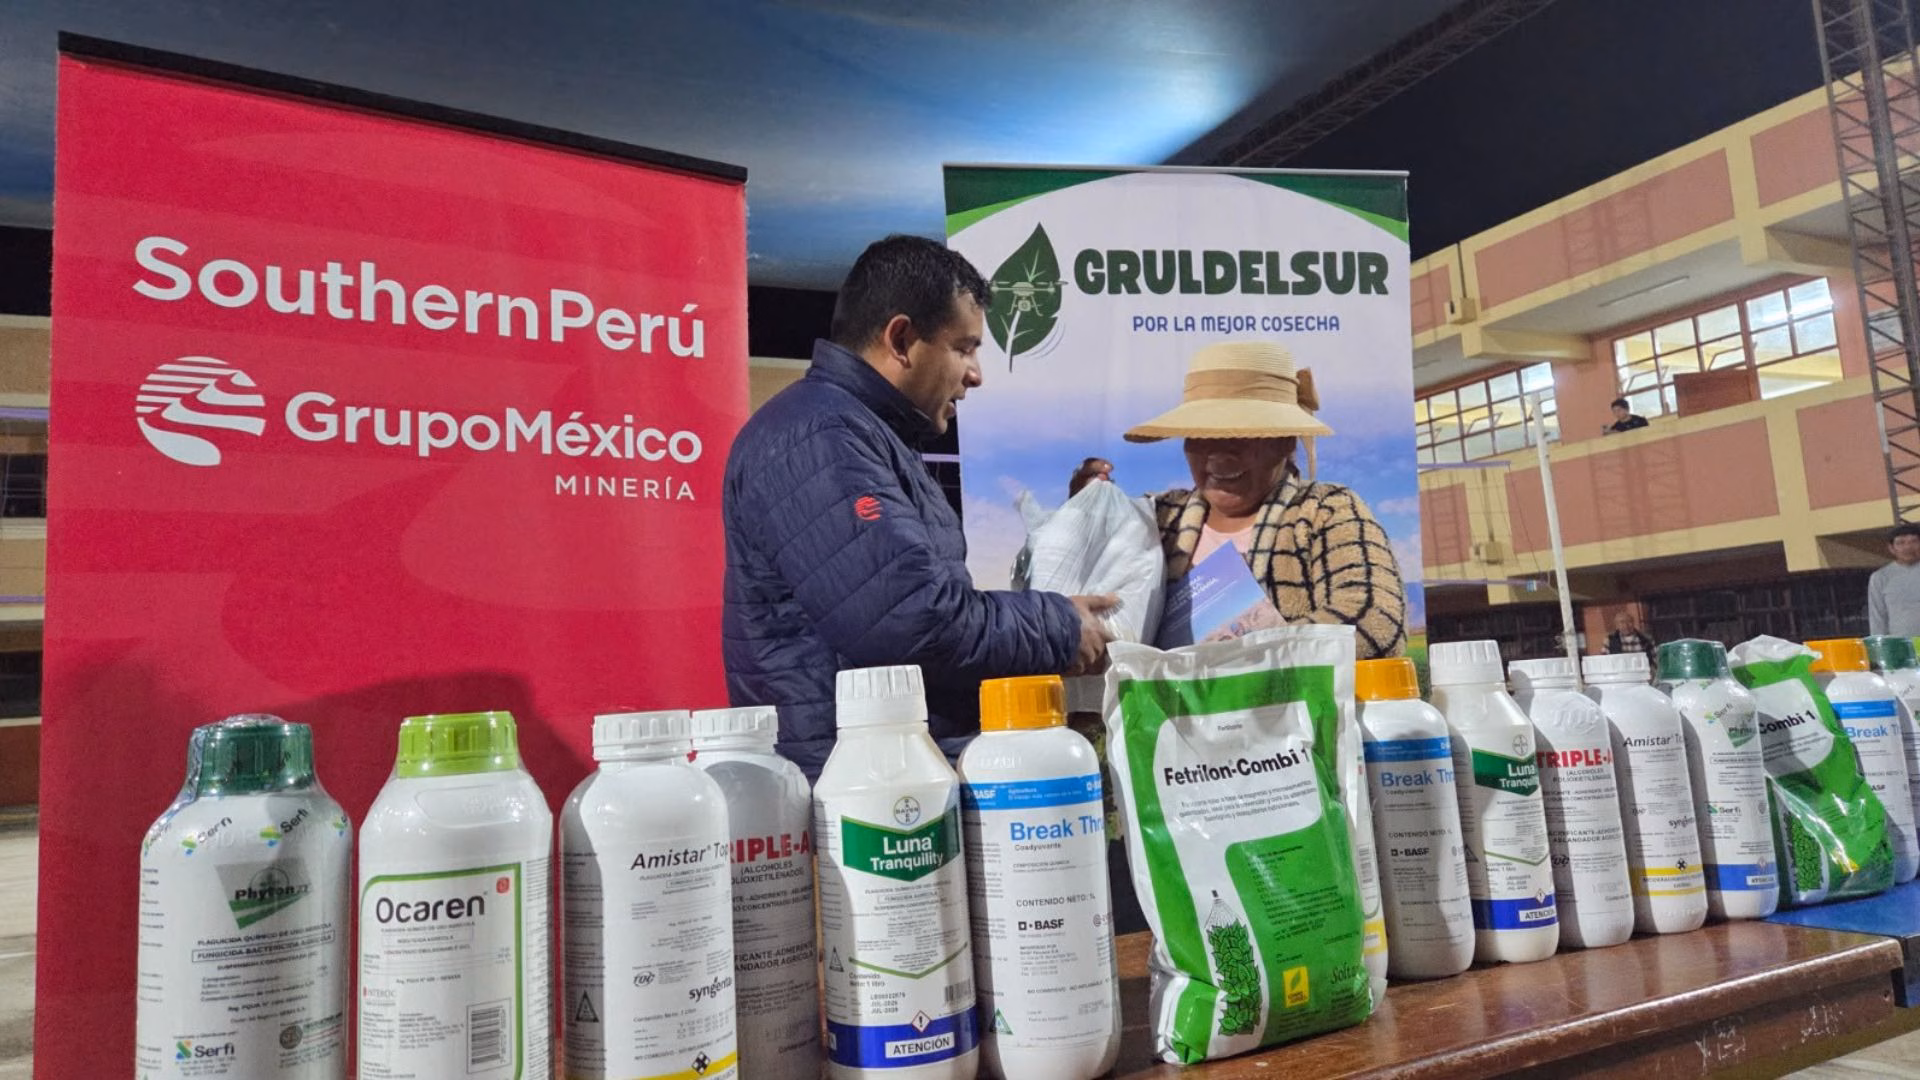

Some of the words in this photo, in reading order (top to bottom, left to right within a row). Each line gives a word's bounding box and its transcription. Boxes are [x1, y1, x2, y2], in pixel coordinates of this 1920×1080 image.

[1073, 248, 1390, 296] GRULDELSUR
[132, 236, 705, 358] SouthernPerú
[1133, 316, 1168, 333] POR
[1173, 316, 1196, 332] LA
[1201, 316, 1257, 335] MEJOR
[1261, 316, 1340, 332] COSECHA
[284, 392, 703, 464] GrupoMéxico
[555, 475, 696, 501] MINERÍA
[1805, 710, 1816, 721] 1
[1623, 735, 1672, 748] Amistar
[1846, 725, 1888, 738] Break
[1381, 770, 1433, 787] Break
[1507, 763, 1535, 777] Luna
[1010, 818, 1074, 841] Break
[730, 830, 811, 864] IPLE-A
[883, 836, 933, 856] Luna
[630, 848, 707, 871] Amistar
[870, 851, 944, 872] Tranquility
[376, 895, 485, 923] Ocaren
[1016, 897, 1065, 908] CONTENIDO
[1035, 918, 1064, 931] BASF
[735, 958, 780, 972] ANDADOR
[194, 1042, 235, 1058] Serfi
[893, 1035, 950, 1055] ATENCIÓN
